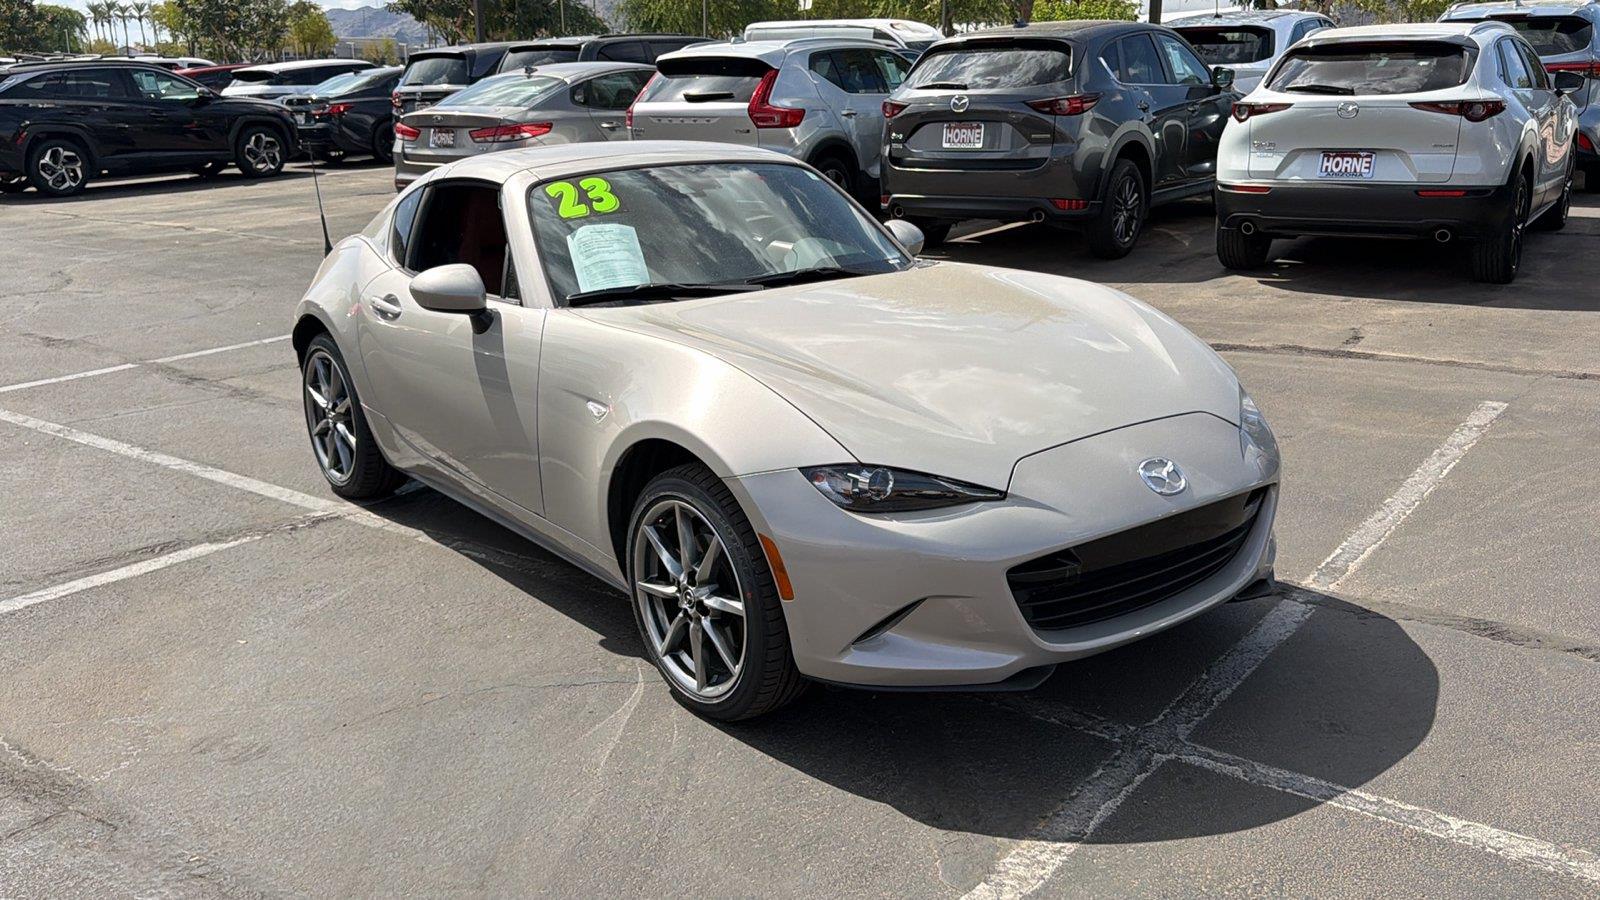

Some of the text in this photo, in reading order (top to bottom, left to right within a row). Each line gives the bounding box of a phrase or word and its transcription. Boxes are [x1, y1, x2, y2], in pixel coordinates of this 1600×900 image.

[433, 132, 454, 145] HORNE
[946, 128, 981, 143] HORNE
[1321, 156, 1372, 173] HORNE
[545, 177, 620, 218] 23
